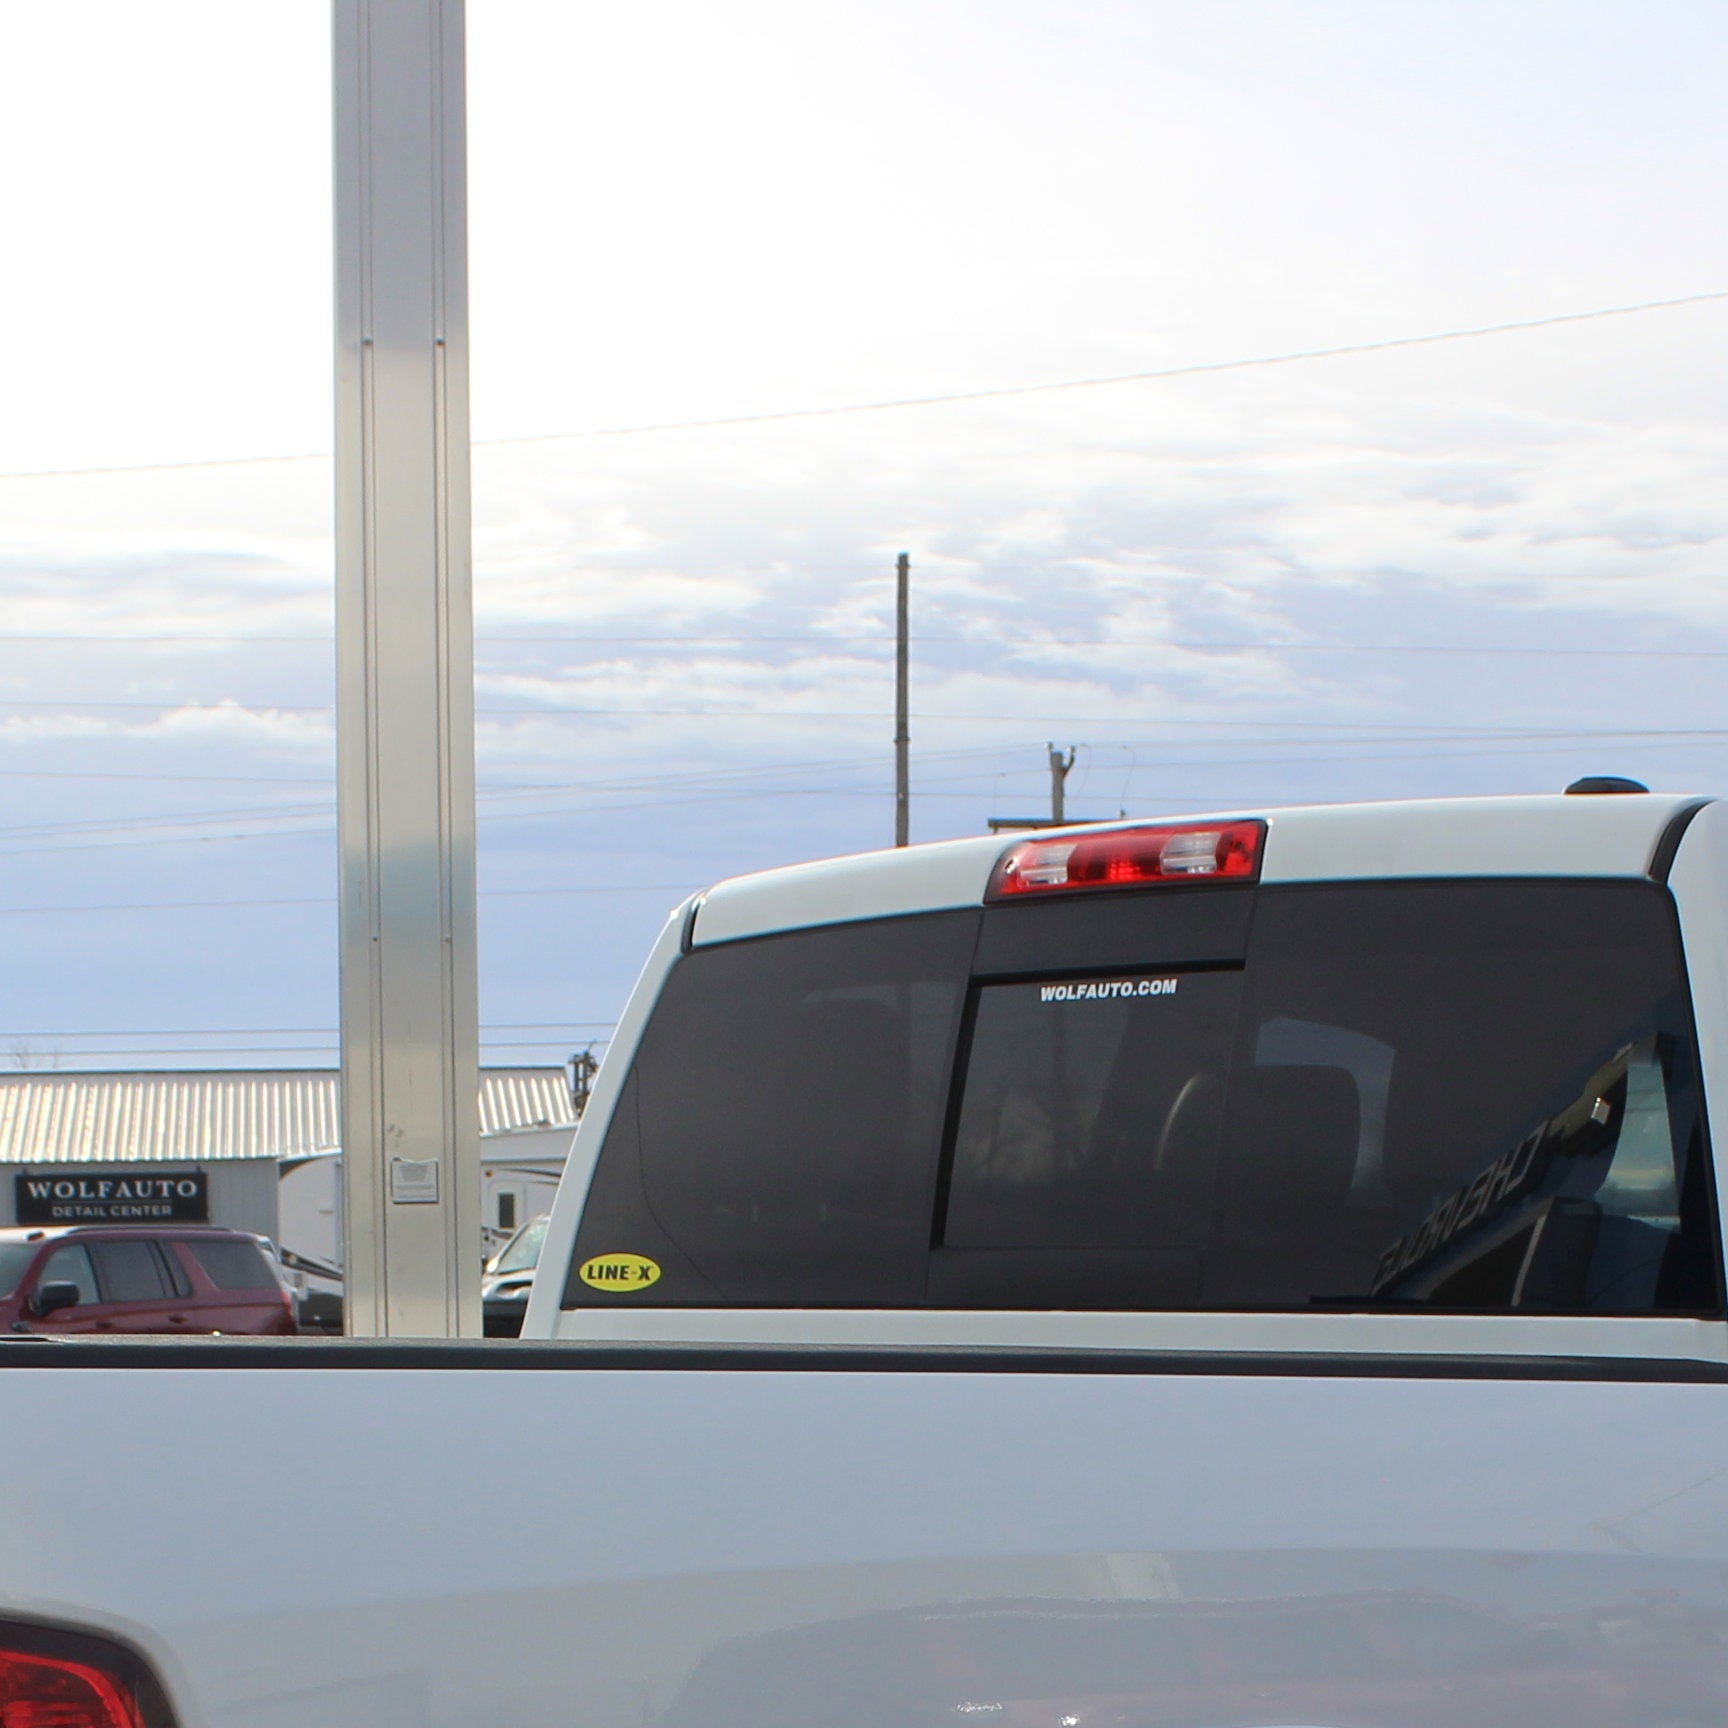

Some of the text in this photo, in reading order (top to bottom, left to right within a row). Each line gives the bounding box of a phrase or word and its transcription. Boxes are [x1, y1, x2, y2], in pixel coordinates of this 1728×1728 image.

[1040, 979, 1178, 1002] WOLFAUTO.COM
[27, 1180, 198, 1199] WOLFAUTO
[52, 1205, 172, 1217] DETAIL CENTER
